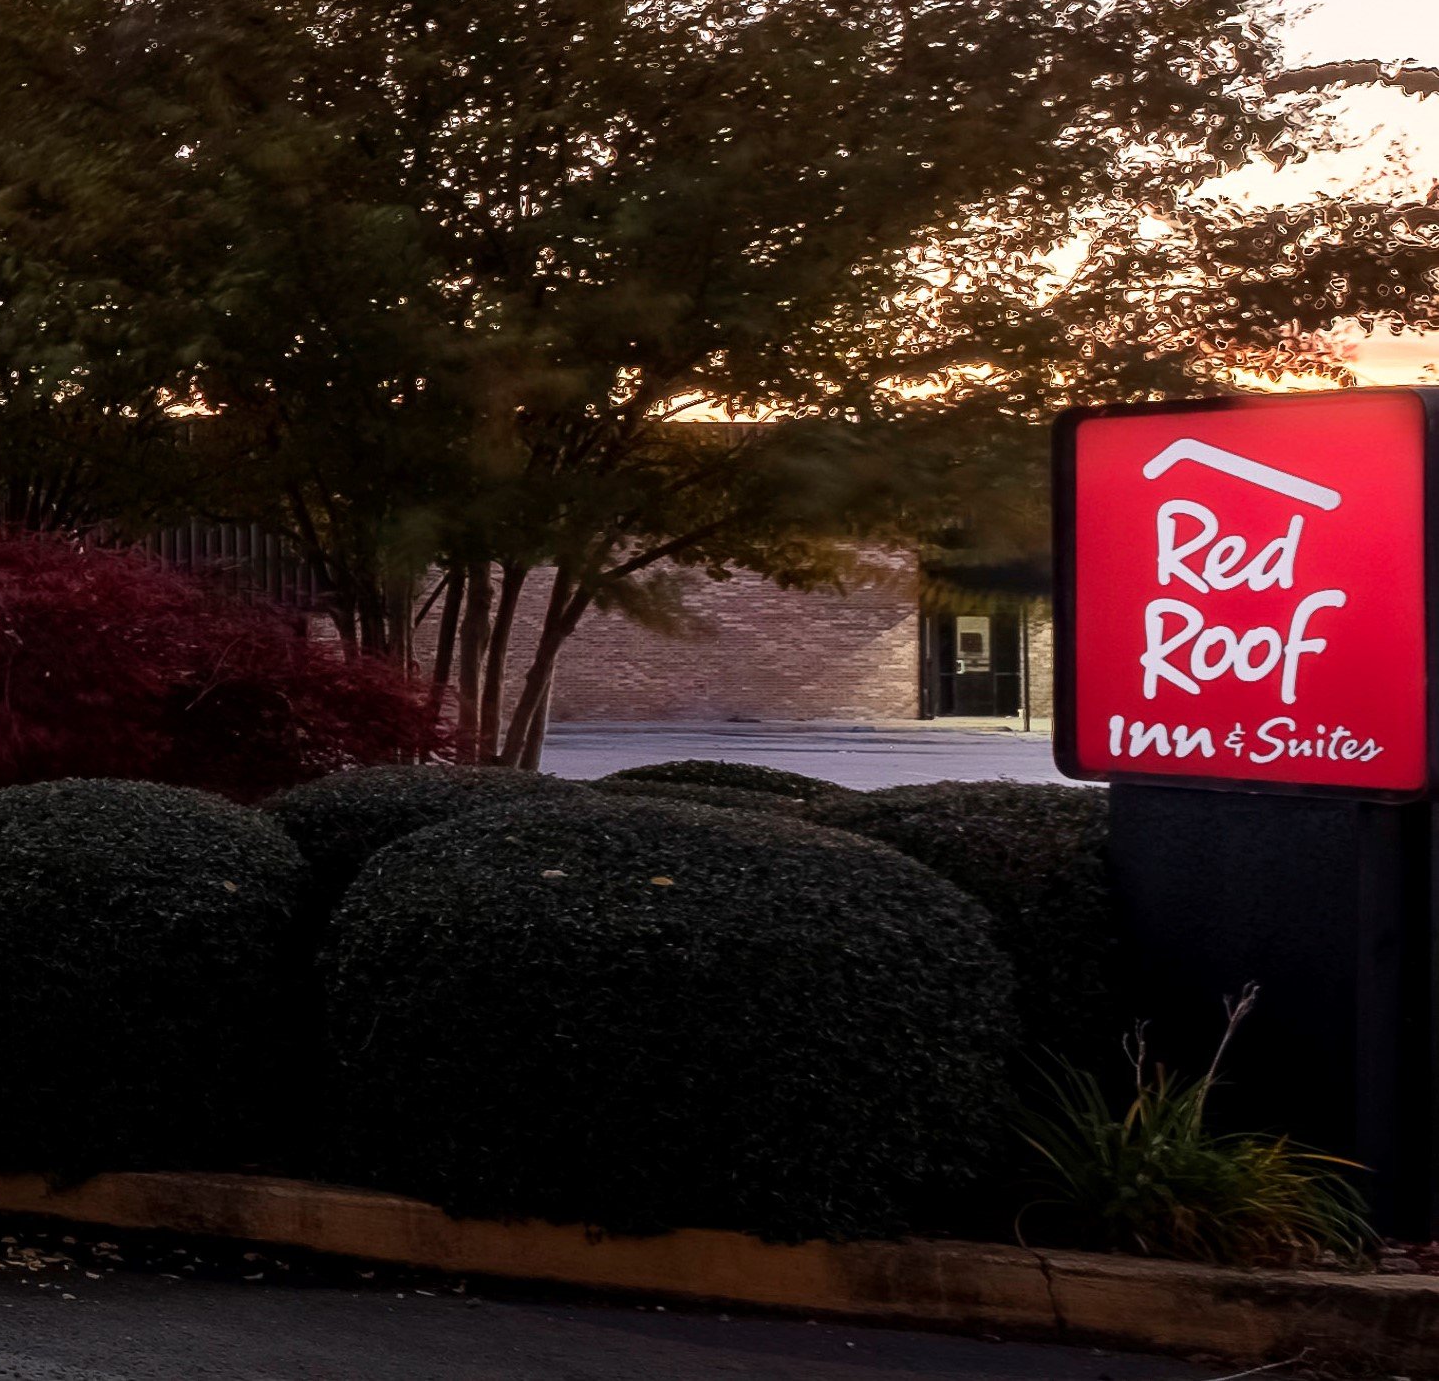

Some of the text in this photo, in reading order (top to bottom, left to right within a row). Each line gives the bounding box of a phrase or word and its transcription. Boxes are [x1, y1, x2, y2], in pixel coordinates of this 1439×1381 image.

[1156, 498, 1305, 594] Red
[1139, 589, 1347, 705] Roof
[1108, 714, 1385, 764] Inn & Suites
